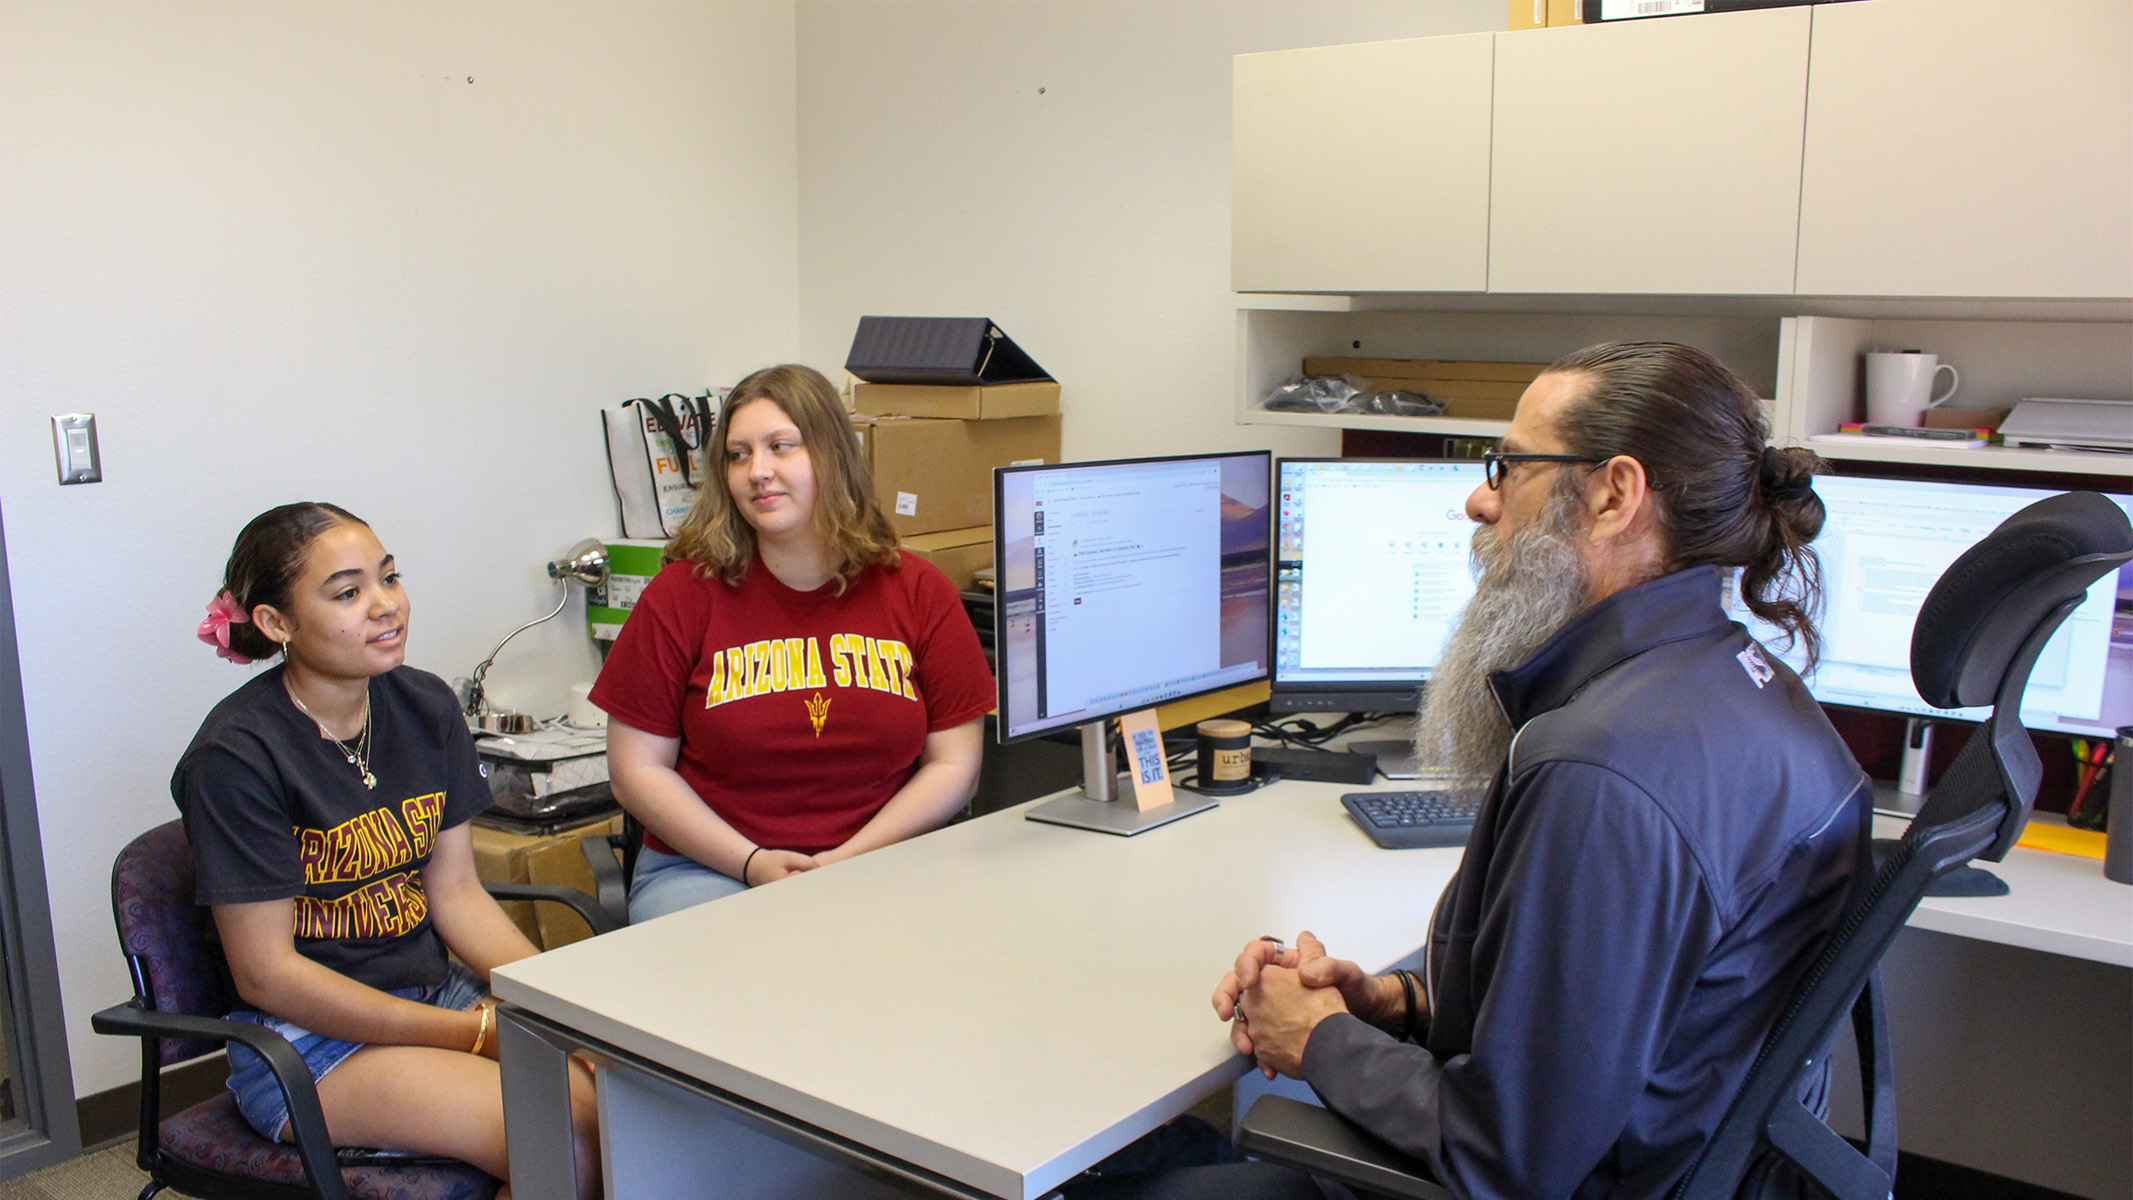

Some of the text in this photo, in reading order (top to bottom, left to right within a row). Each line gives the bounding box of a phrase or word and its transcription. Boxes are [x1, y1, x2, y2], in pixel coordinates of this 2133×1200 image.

[656, 455, 699, 474] FUL
[706, 633, 918, 709] ARIZONA STATE
[1138, 753, 1160, 769] THIS
[1141, 770, 1151, 785] IS
[293, 807, 413, 885] RIZONA
